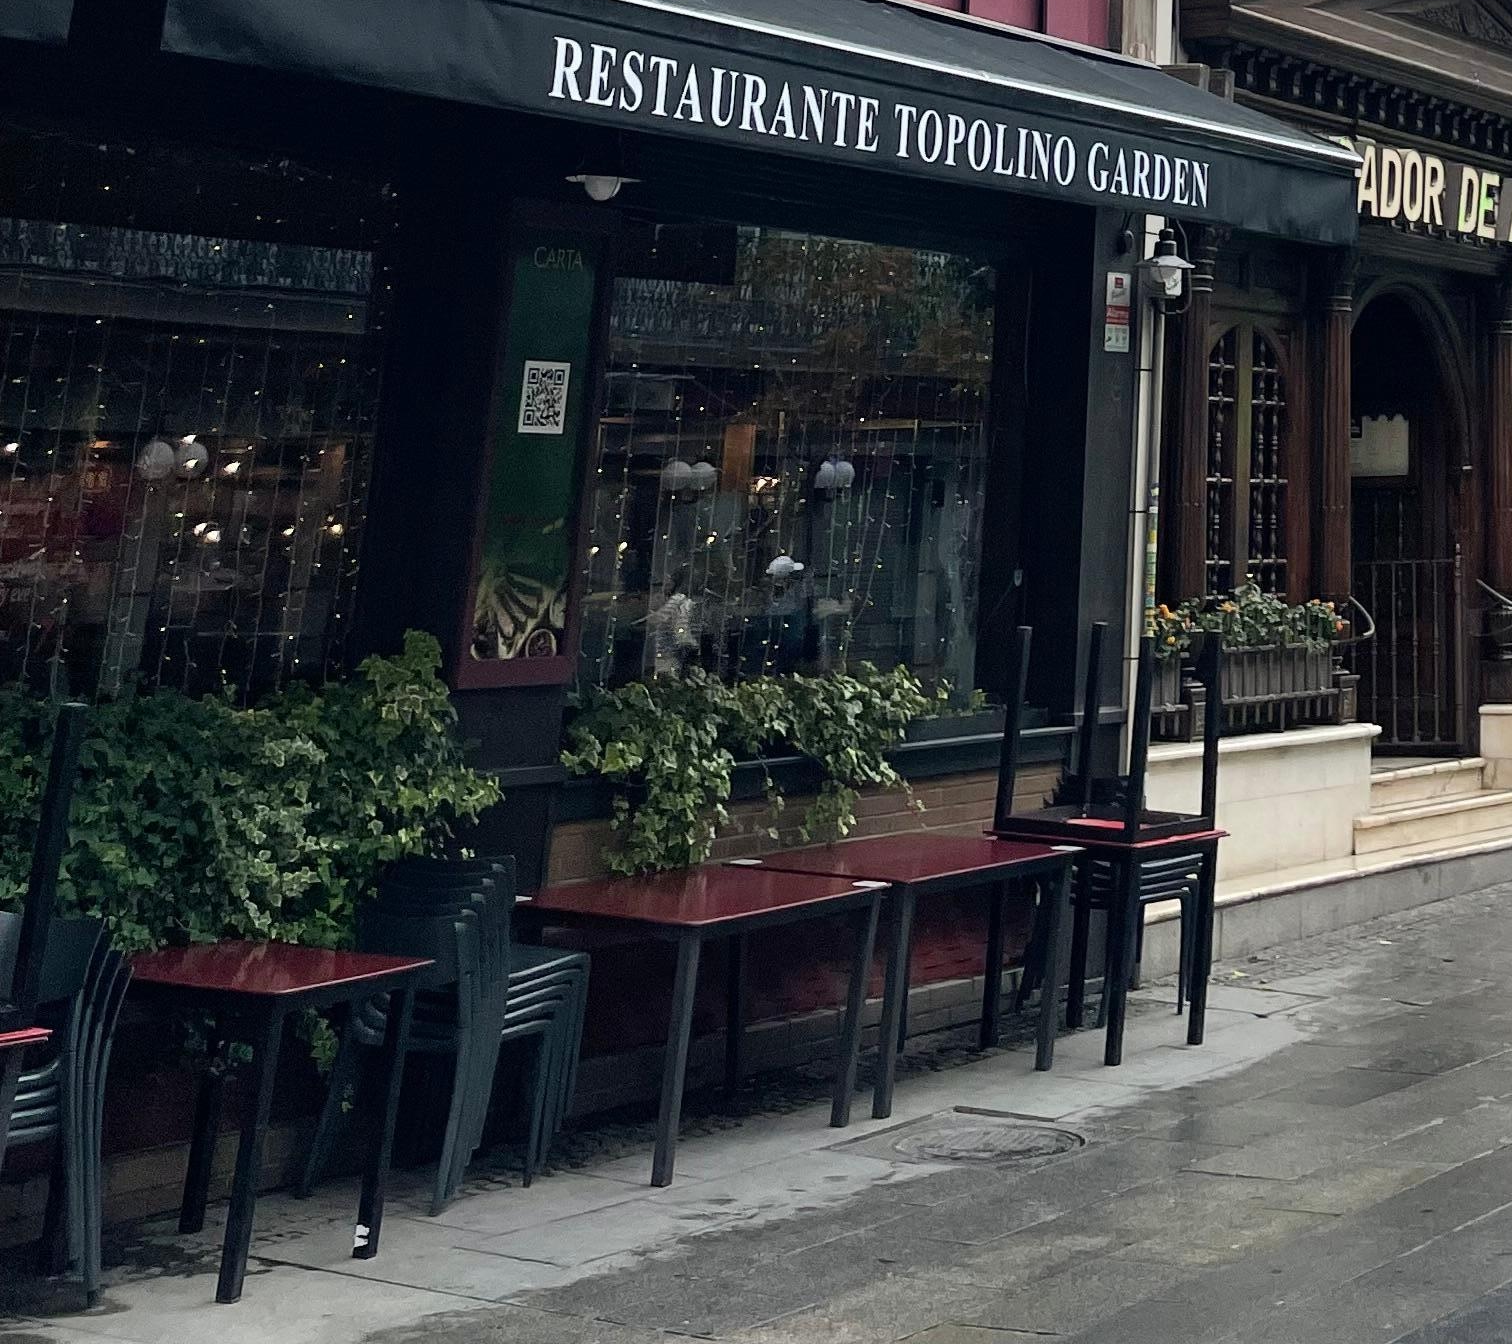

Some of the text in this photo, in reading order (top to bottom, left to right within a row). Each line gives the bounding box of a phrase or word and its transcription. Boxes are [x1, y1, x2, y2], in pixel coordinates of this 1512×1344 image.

[548, 36, 1210, 209] RESTAURANTE TOPOLINO GARDEN
[1355, 144, 1445, 227] ADOR
[1458, 166, 1501, 240] DE
[533, 245, 584, 272] CARTA
